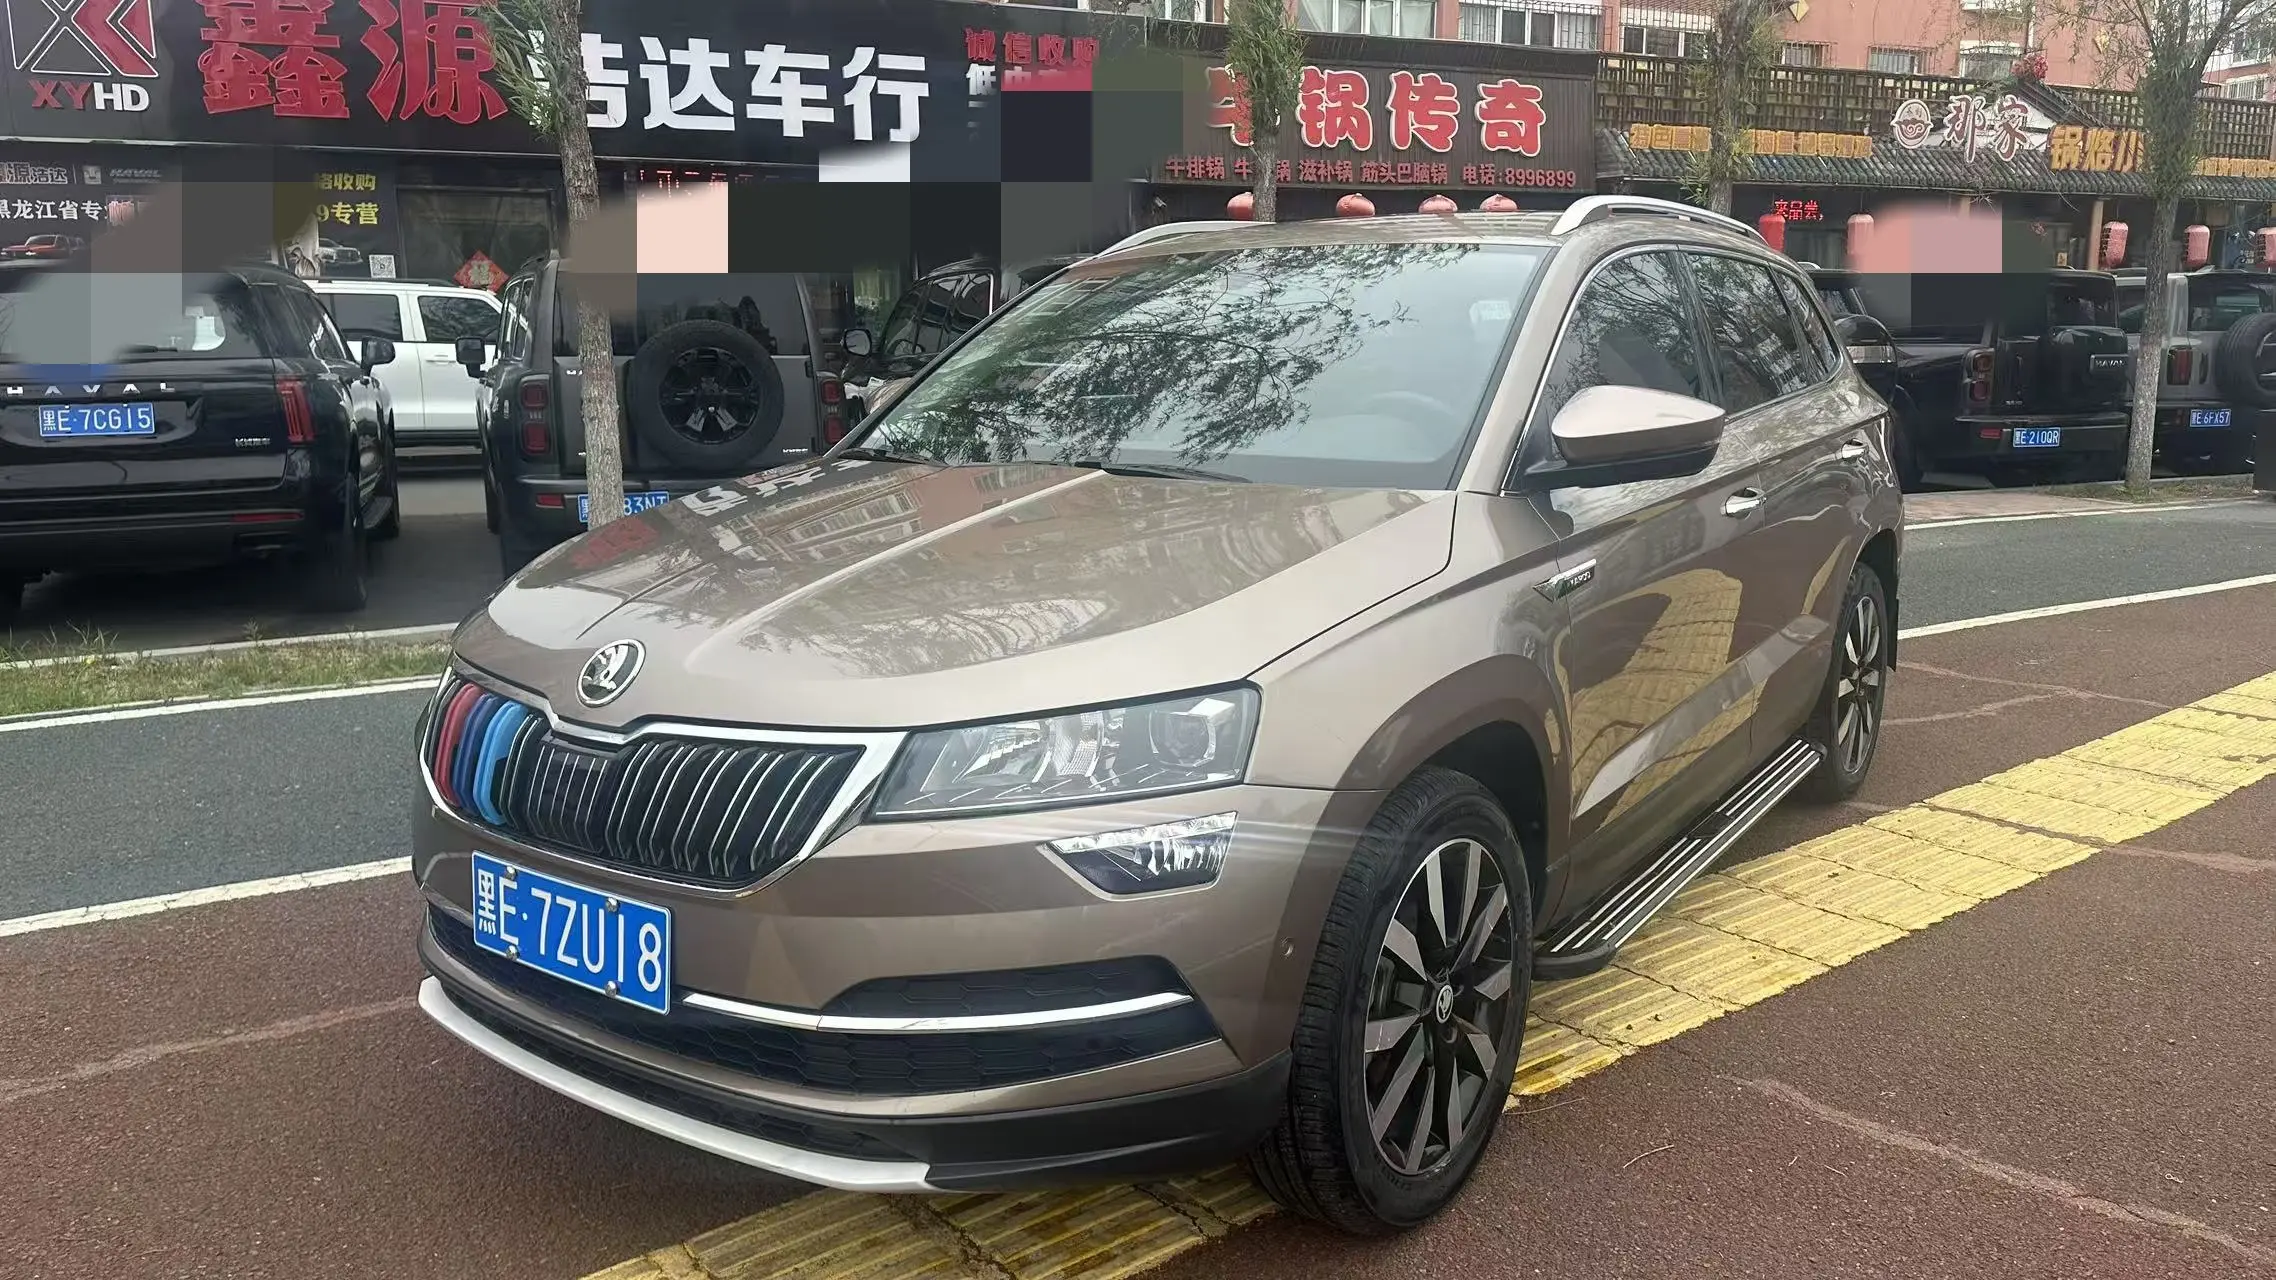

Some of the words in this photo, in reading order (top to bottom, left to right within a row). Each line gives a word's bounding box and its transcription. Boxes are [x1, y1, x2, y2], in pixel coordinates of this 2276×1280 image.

[28, 78, 150, 111] XYHD
[1165, 155, 1225, 180] 牛排锅
[1234, 157, 1291, 182] 牛锅
[1299, 159, 1352, 183] 滋补锅
[1360, 161, 1448, 185] 筋头巴脑锅
[0, 199, 108, 221] 黑龙江省专
[6, 382, 176, 397] HAVAL
